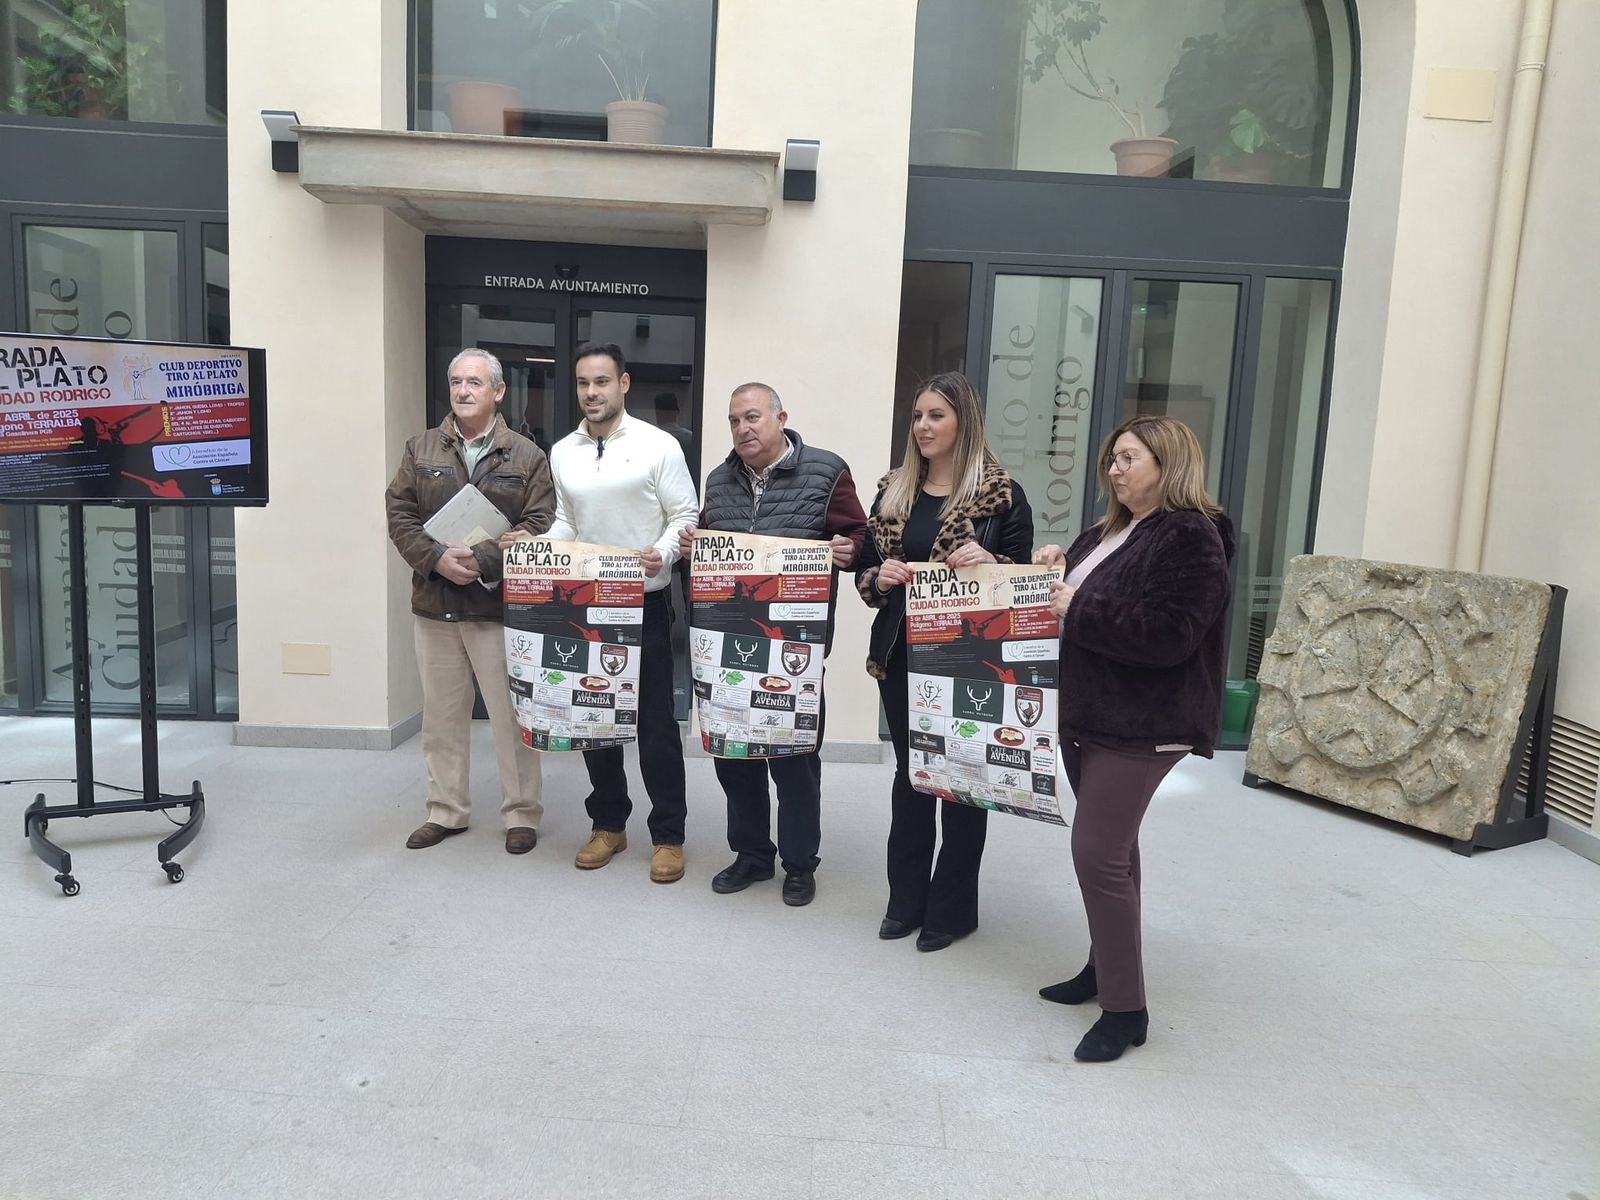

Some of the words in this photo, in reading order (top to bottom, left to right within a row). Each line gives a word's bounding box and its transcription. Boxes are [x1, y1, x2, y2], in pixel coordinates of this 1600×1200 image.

[484, 275, 545, 290] ENTRADA
[550, 279, 649, 296] AYUNTAMIENTO
[35, 277, 80, 336] de
[992, 324, 1036, 381] de
[159, 360, 184, 371] CLUB
[187, 359, 242, 370] DEPORTIVO
[16, 365, 108, 389] PLATO
[165, 372, 190, 382] TIRO
[192, 371, 206, 380] AL
[206, 369, 239, 380] PLATO
[40, 387, 112, 404] RODRIGO
[166, 381, 245, 398] MIRÓBRIGA
[4, 412, 34, 422] ABRIL
[37, 411, 49, 420] de
[53, 409, 79, 419] 2025
[27, 418, 82, 430] TERRALBA
[694, 536, 735, 550] TIRADA
[506, 553, 522, 565] AL
[527, 554, 571, 566] PLATO
[693, 549, 707, 562] AL
[711, 549, 754, 562] PLATO
[506, 567, 534, 575] CIUDAD
[536, 567, 570, 576] RODRIGO
[598, 569, 643, 578] MIRÓBRIGA
[693, 563, 717, 572] CIUDAD
[719, 562, 753, 571] RODRIGO
[782, 562, 829, 572] MIRÓBRIGA
[1010, 576, 1026, 584] CLUB
[1027, 573, 1059, 583] DEPORTIVO
[1038, 581, 1053, 589] PLAT
[909, 586, 926, 600] AL
[931, 580, 980, 598] PLATO
[910, 600, 938, 610] CIUDAD
[941, 597, 980, 608] RODRIGO
[1013, 591, 1051, 604] MIRÓBRI
[97, 526, 141, 690] Ciudad
[933, 618, 962, 627] TERRALBA
[576, 695, 611, 705] AVENIDA
[755, 697, 791, 707] AVENIDA
[990, 752, 1026, 765] AVENIDA
